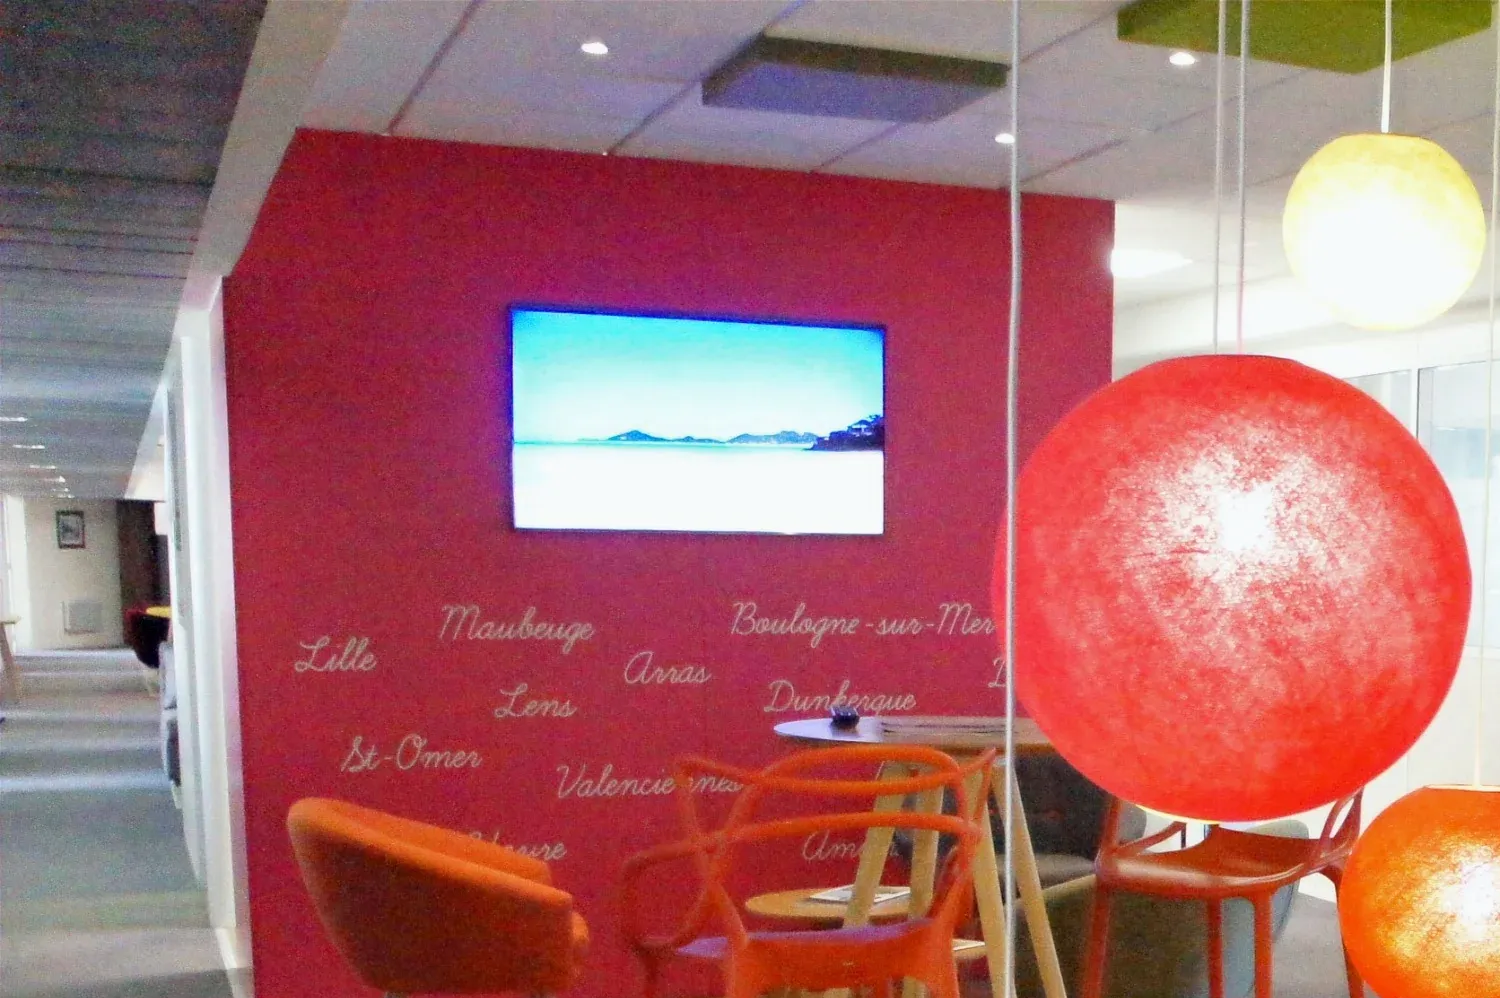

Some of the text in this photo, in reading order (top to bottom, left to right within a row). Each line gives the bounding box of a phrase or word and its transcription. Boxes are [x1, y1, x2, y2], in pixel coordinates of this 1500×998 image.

[438, 604, 595, 655] Maubeuge
[731, 600, 996, 649] Boulogne-sur-Mer
[295, 635, 377, 673] Lille
[623, 650, 711, 686] Arras
[494, 683, 577, 718] Lens
[763, 679, 917, 716] Dunkerque
[341, 733, 482, 773] St-Omer
